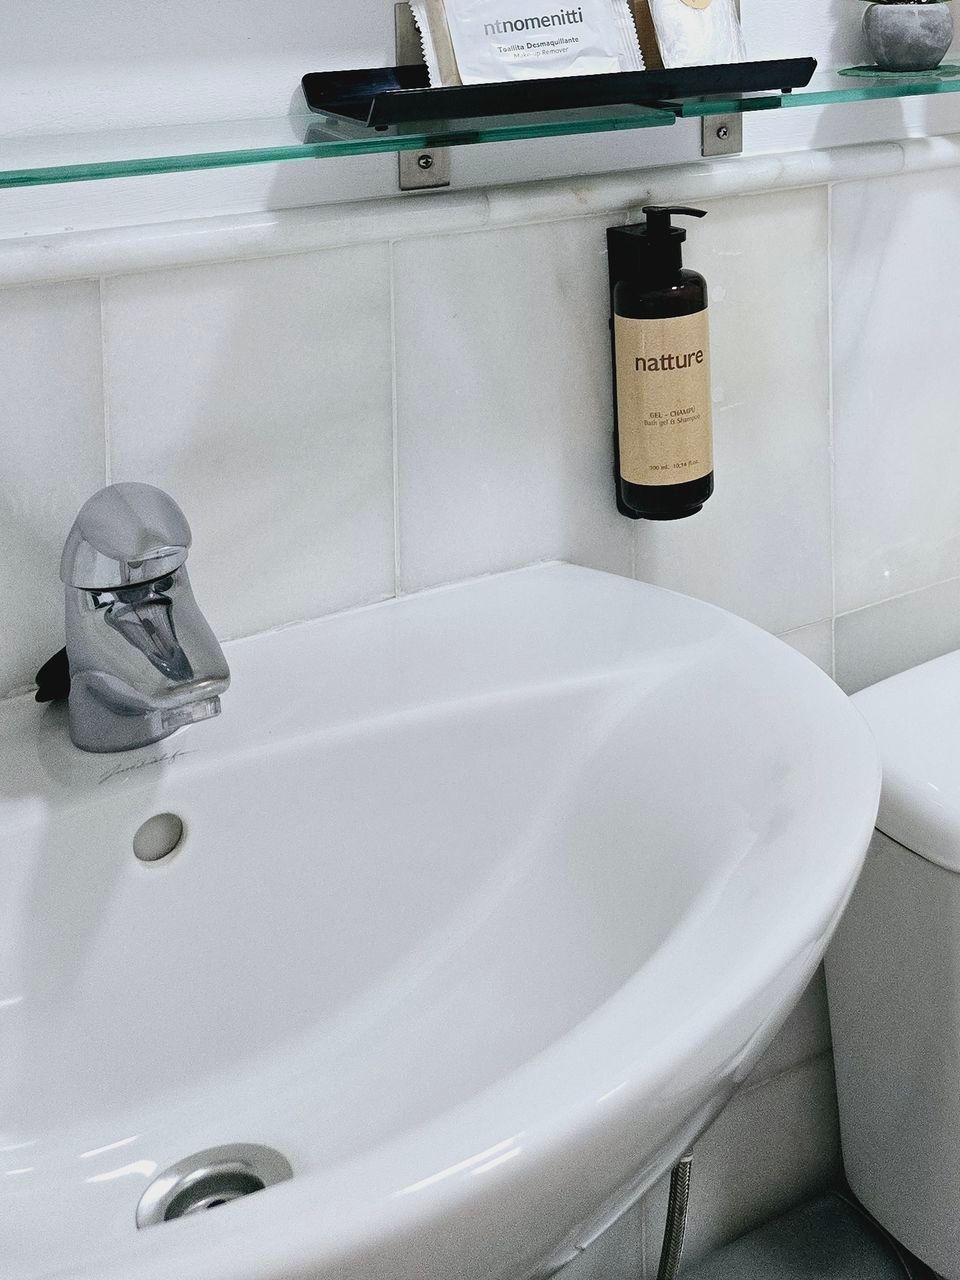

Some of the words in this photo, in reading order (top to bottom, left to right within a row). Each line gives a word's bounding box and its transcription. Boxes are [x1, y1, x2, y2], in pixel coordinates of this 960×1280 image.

[483, 7, 583, 35] ntnomenitti
[497, 43, 525, 53] Toallita
[526, 36, 579, 49] Desmaquillante
[513, 50, 541, 59] Mke-up
[542, 46, 569, 55] Remover
[635, 349, 703, 371] natture
